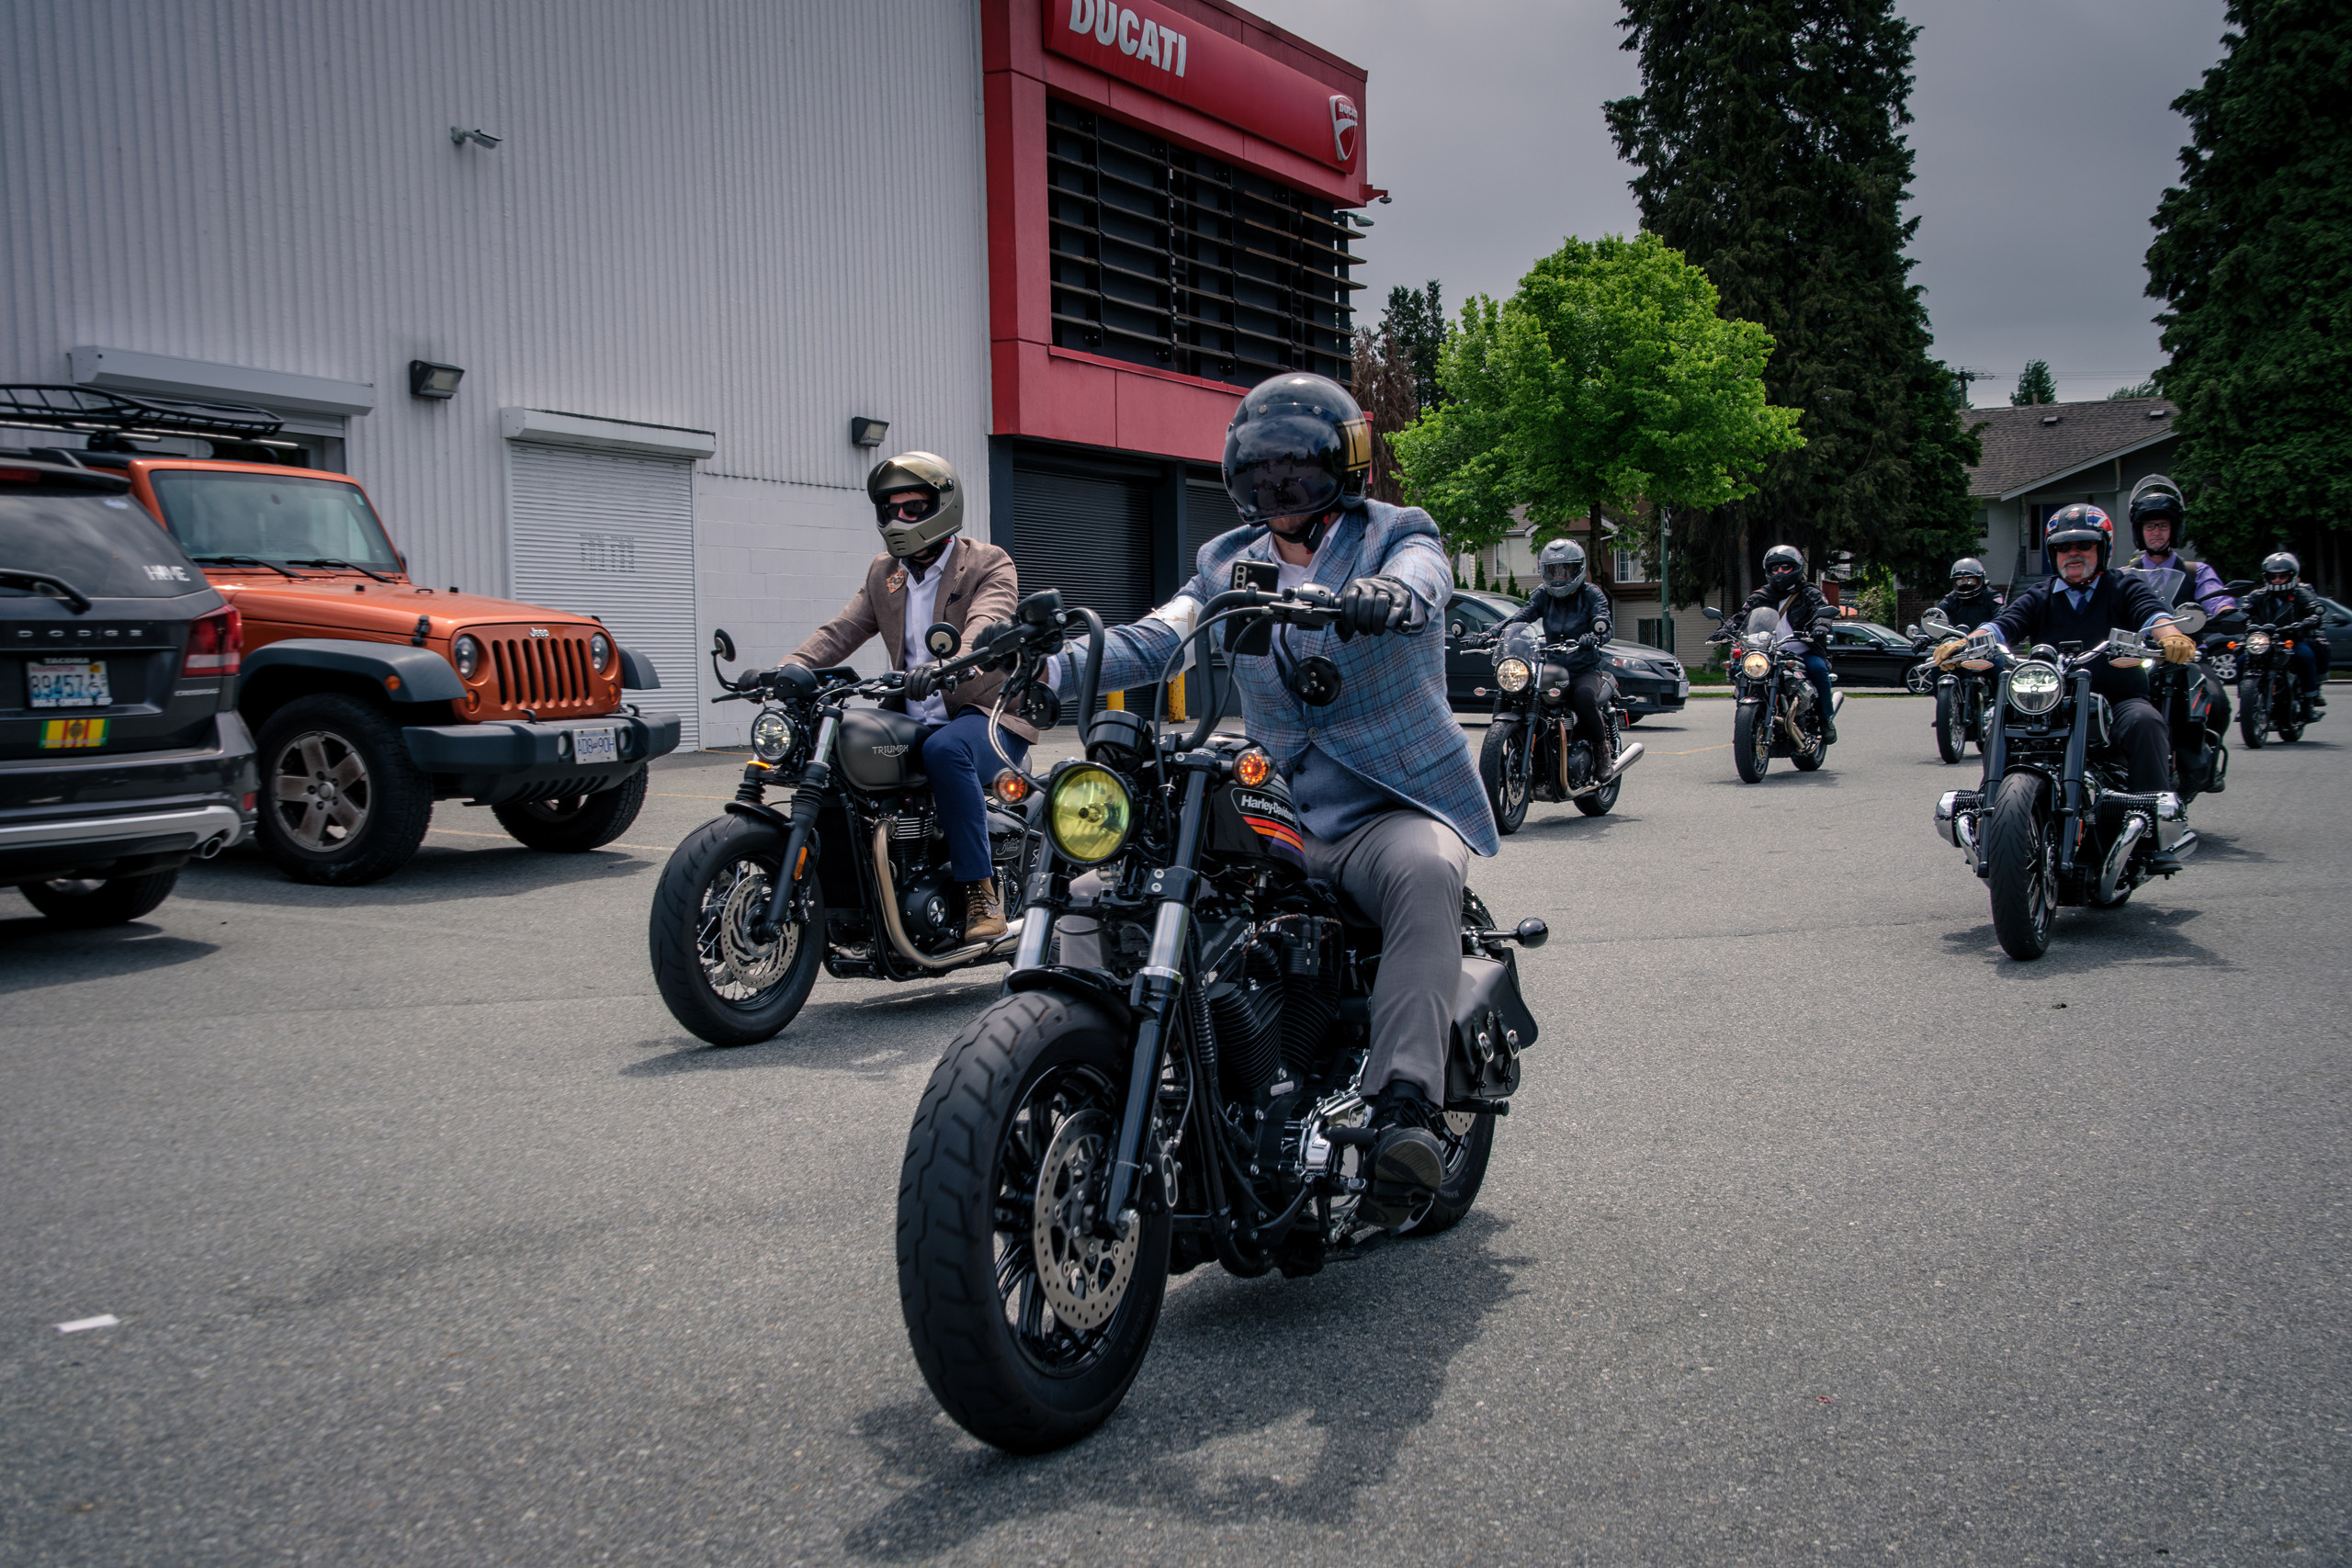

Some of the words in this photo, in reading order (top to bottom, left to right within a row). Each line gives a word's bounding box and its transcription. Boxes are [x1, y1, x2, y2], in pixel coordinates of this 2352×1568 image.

[1069, 0, 1187, 78] DUCATI
[529, 627, 549, 639] Jeep
[872, 744, 909, 755] TRIUMPH
